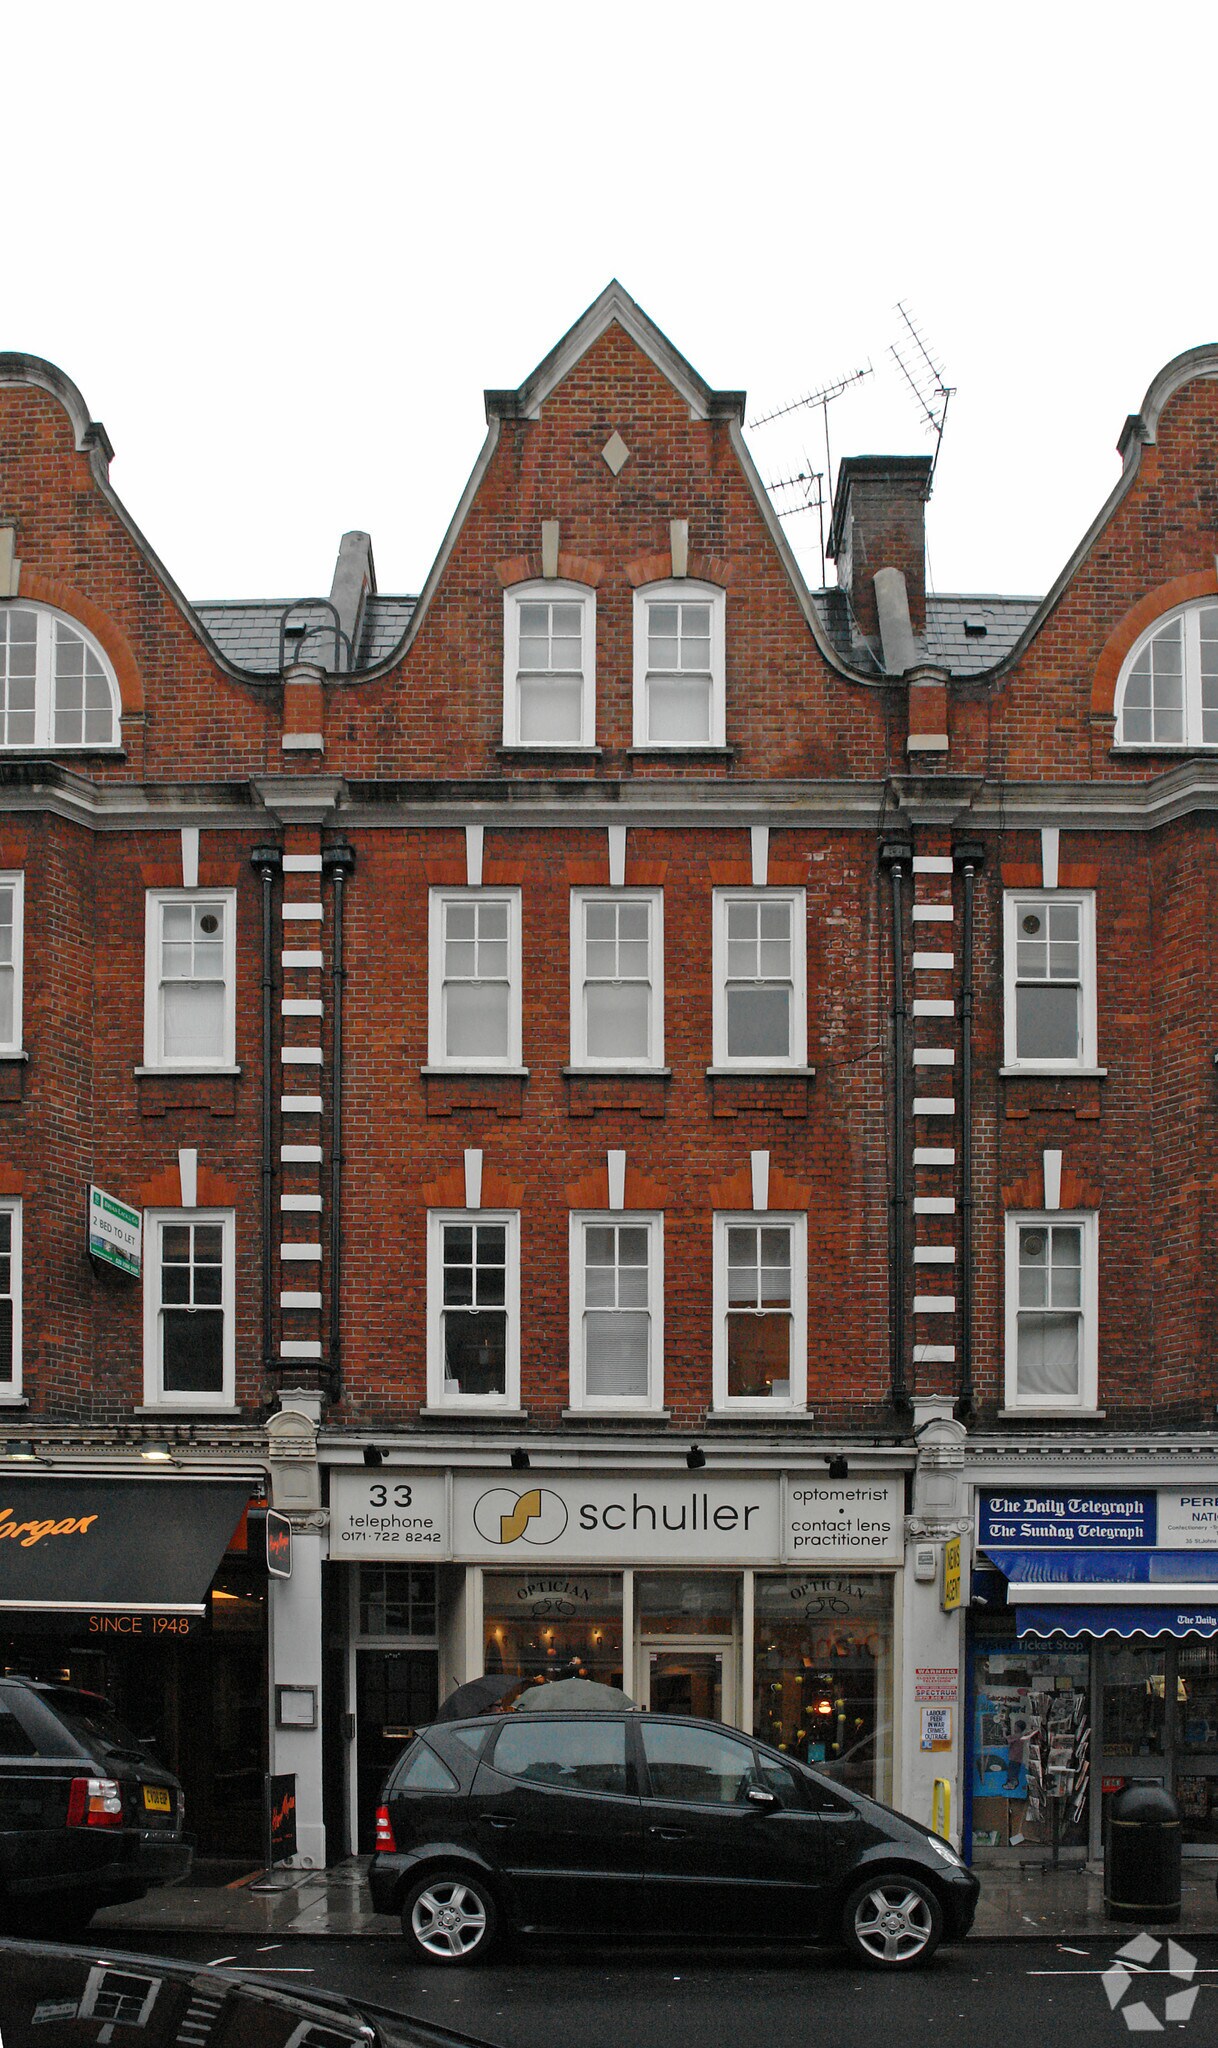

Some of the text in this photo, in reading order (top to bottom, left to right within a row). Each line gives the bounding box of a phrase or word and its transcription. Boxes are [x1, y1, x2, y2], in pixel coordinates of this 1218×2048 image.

[93, 1216, 135, 1246] 2 BED TO LET
[369, 1484, 412, 1508] 33
[793, 1488, 888, 1506] optometrist
[579, 1493, 760, 1531] schuller
[989, 1498, 1144, 1517] The Daily Telegraph
[349, 1514, 433, 1531] telephone
[791, 1518, 891, 1532] contact lens
[989, 1523, 1144, 1540] The Sunday Telegraph
[405, 1533, 441, 1543] 8242
[794, 1534, 888, 1549] practitioner
[517, 1581, 592, 1601] OPTICIAN
[790, 1580, 866, 1600] OPTICIAN
[89, 1616, 189, 1634] SINCE 1948
[1177, 1615, 1216, 1626] The Daily
[1017, 1640, 1053, 1650] Ticket
[1056, 1640, 1083, 1653] Stop
